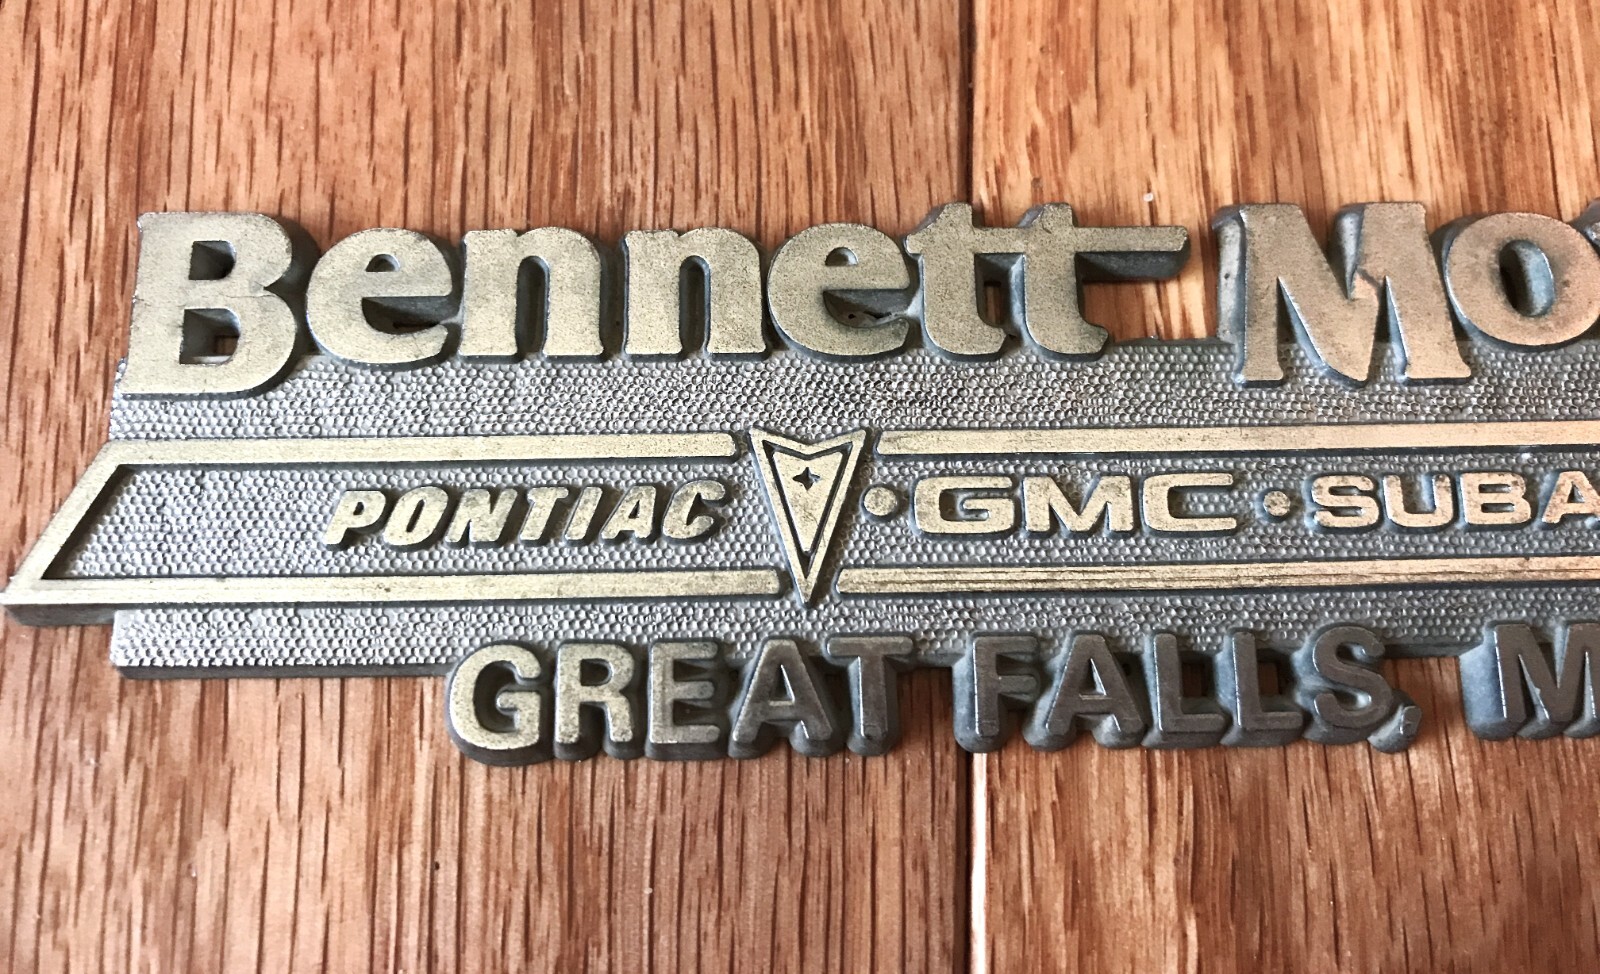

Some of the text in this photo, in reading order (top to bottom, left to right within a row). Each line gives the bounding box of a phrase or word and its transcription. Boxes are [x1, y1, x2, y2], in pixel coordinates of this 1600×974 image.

[117, 201, 1600, 395] Bennett Mo
[323, 470, 1600, 548] PONTIAC GMC SUBA
[448, 634, 915, 755] GREAT
[966, 624, 1424, 745] FALLS,
